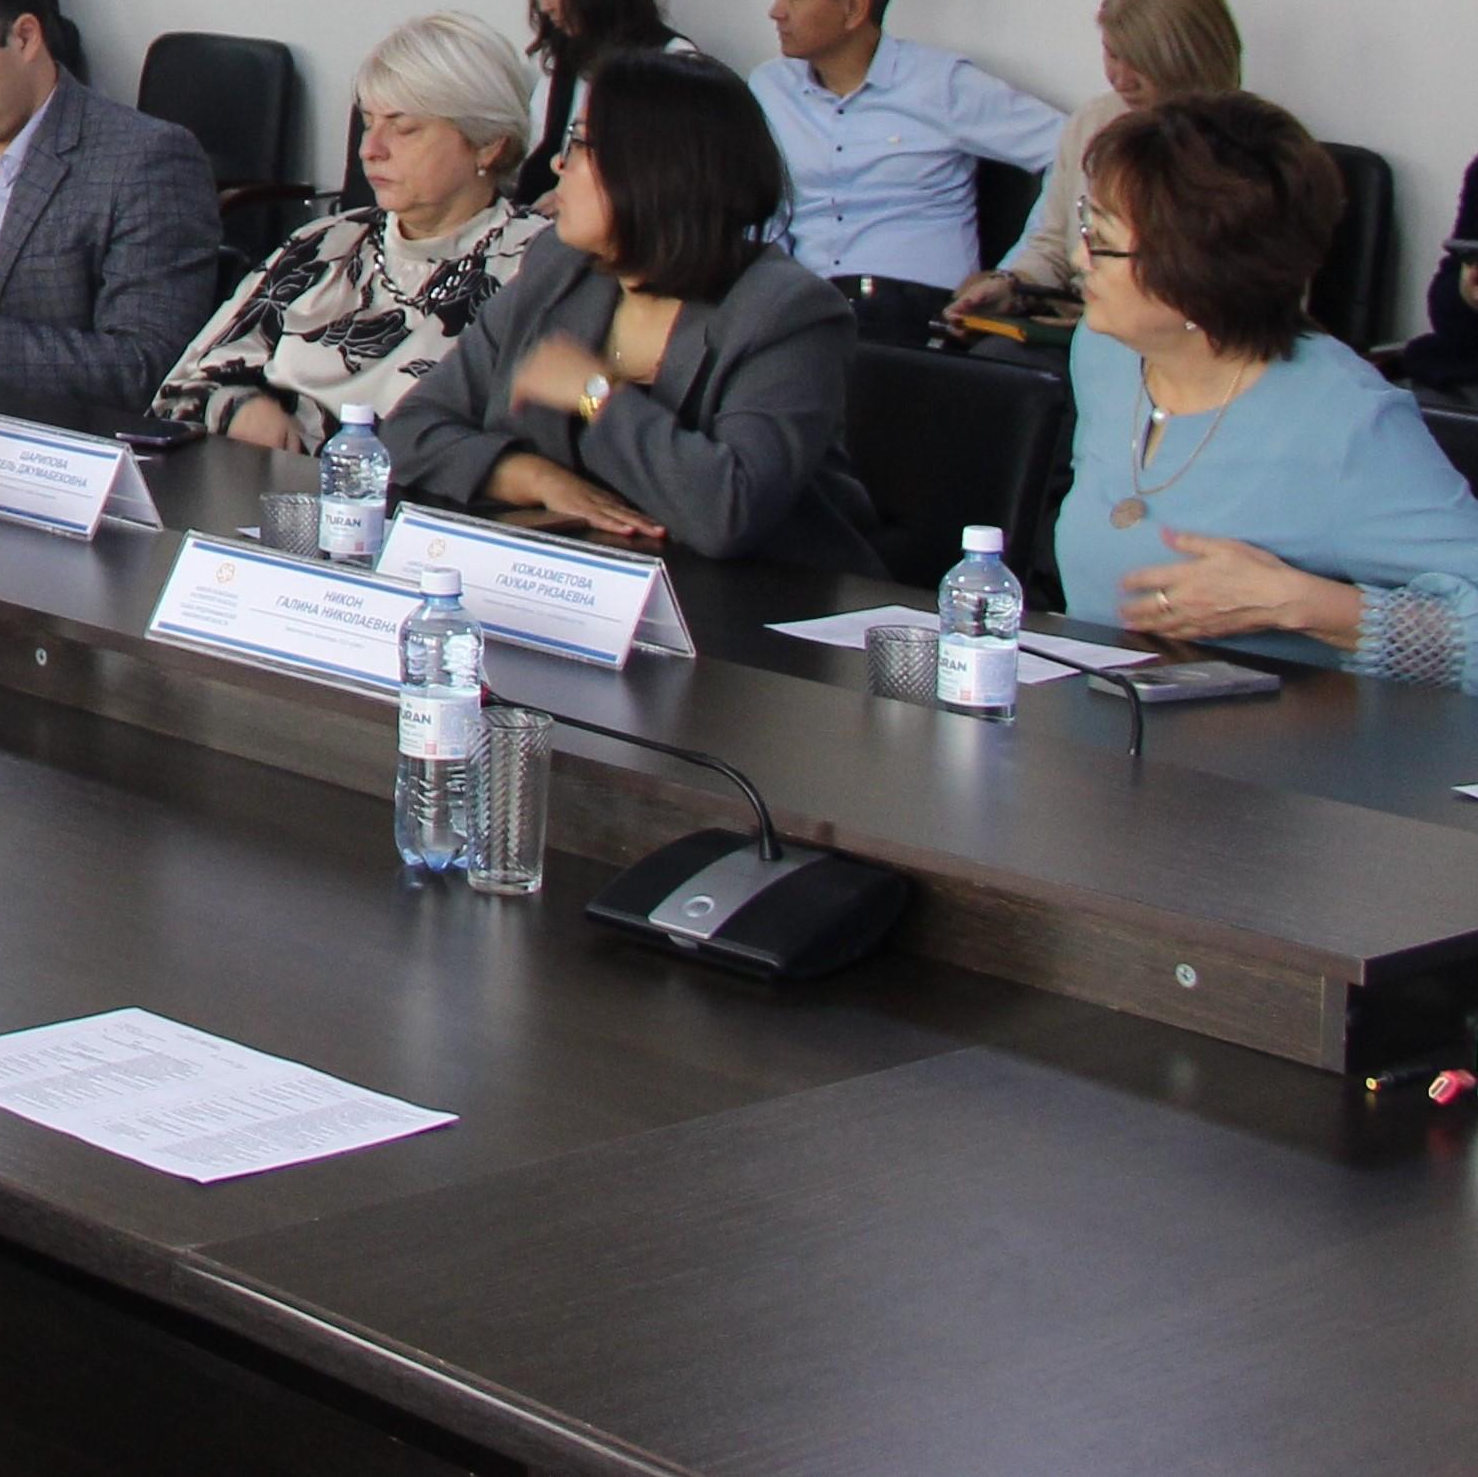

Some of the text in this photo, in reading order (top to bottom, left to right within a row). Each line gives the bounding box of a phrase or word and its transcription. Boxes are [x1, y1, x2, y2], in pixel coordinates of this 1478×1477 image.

[325, 513, 362, 528] TURAN
[495, 573, 595, 607] ГАУХАР РИЗАЕВНА
[511, 561, 594, 590] КОЖАХМЕТОВА
[323, 590, 364, 609] НИКОН
[275, 595, 397, 635] ГАЛИНА НИКОЛАЕВНА
